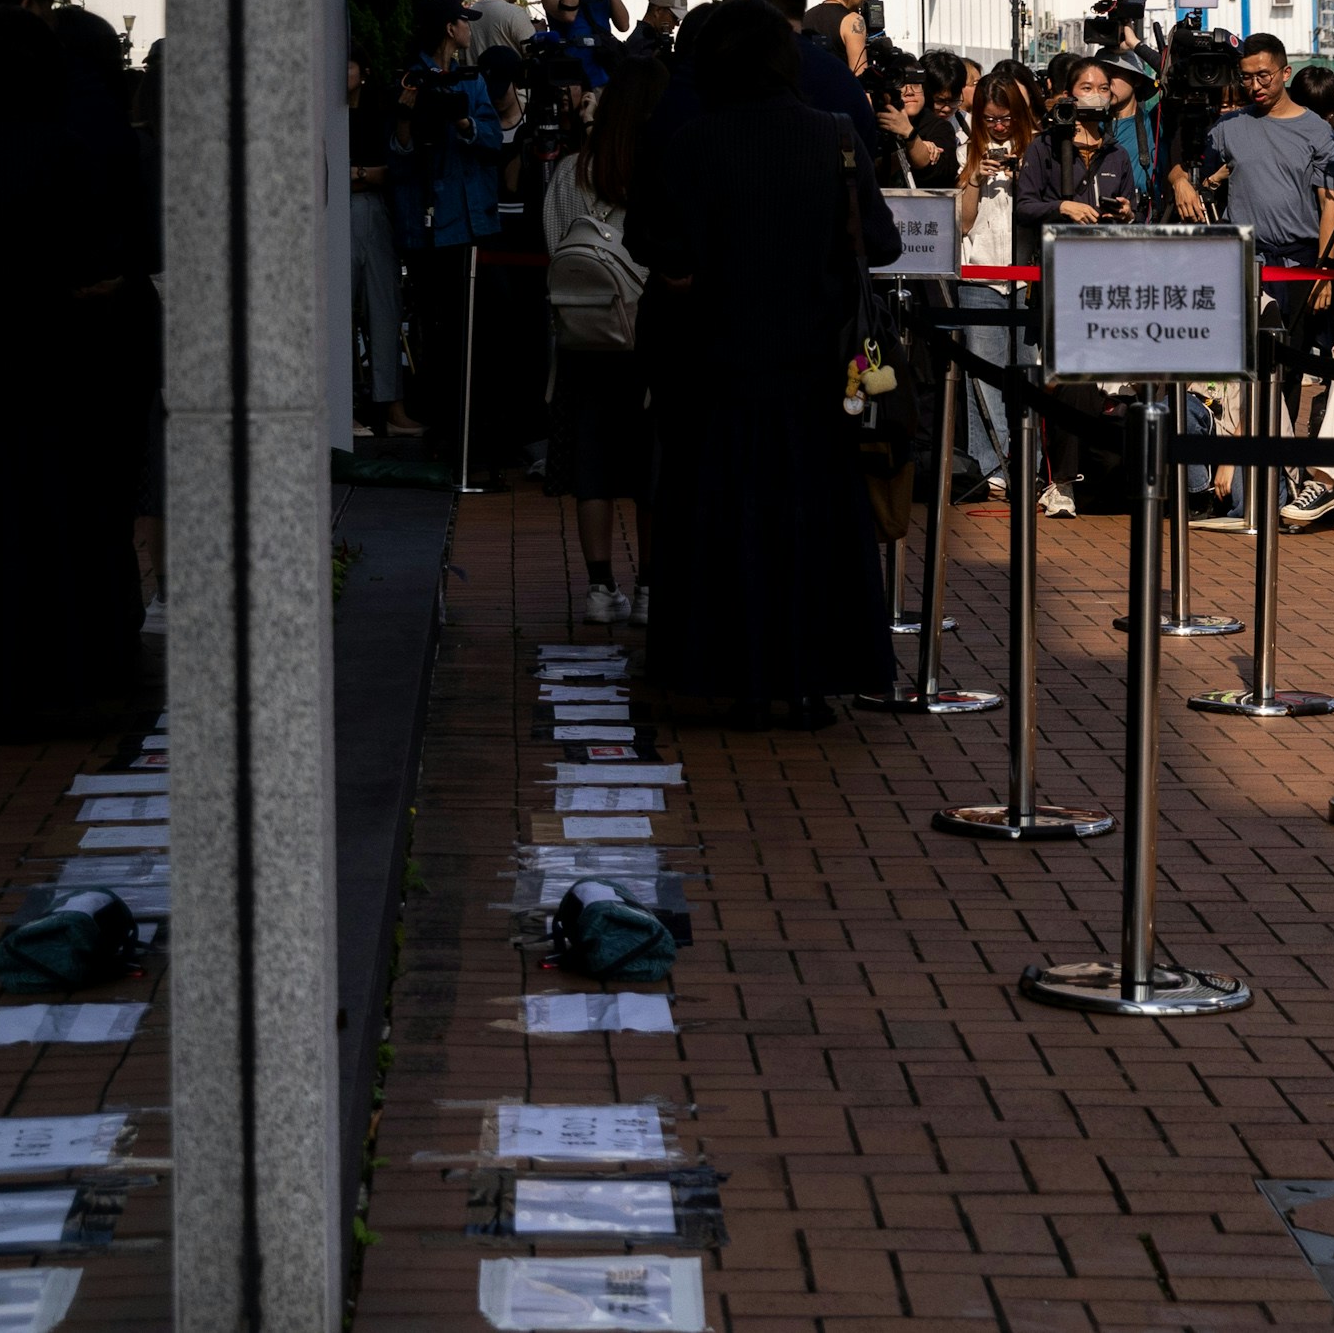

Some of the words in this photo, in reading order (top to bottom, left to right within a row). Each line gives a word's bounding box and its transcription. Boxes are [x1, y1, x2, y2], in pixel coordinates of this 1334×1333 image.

[1078, 284, 1216, 311] 傳媒排隊處
[1087, 322, 1139, 340] Press
[1146, 321, 1211, 344] Queue
